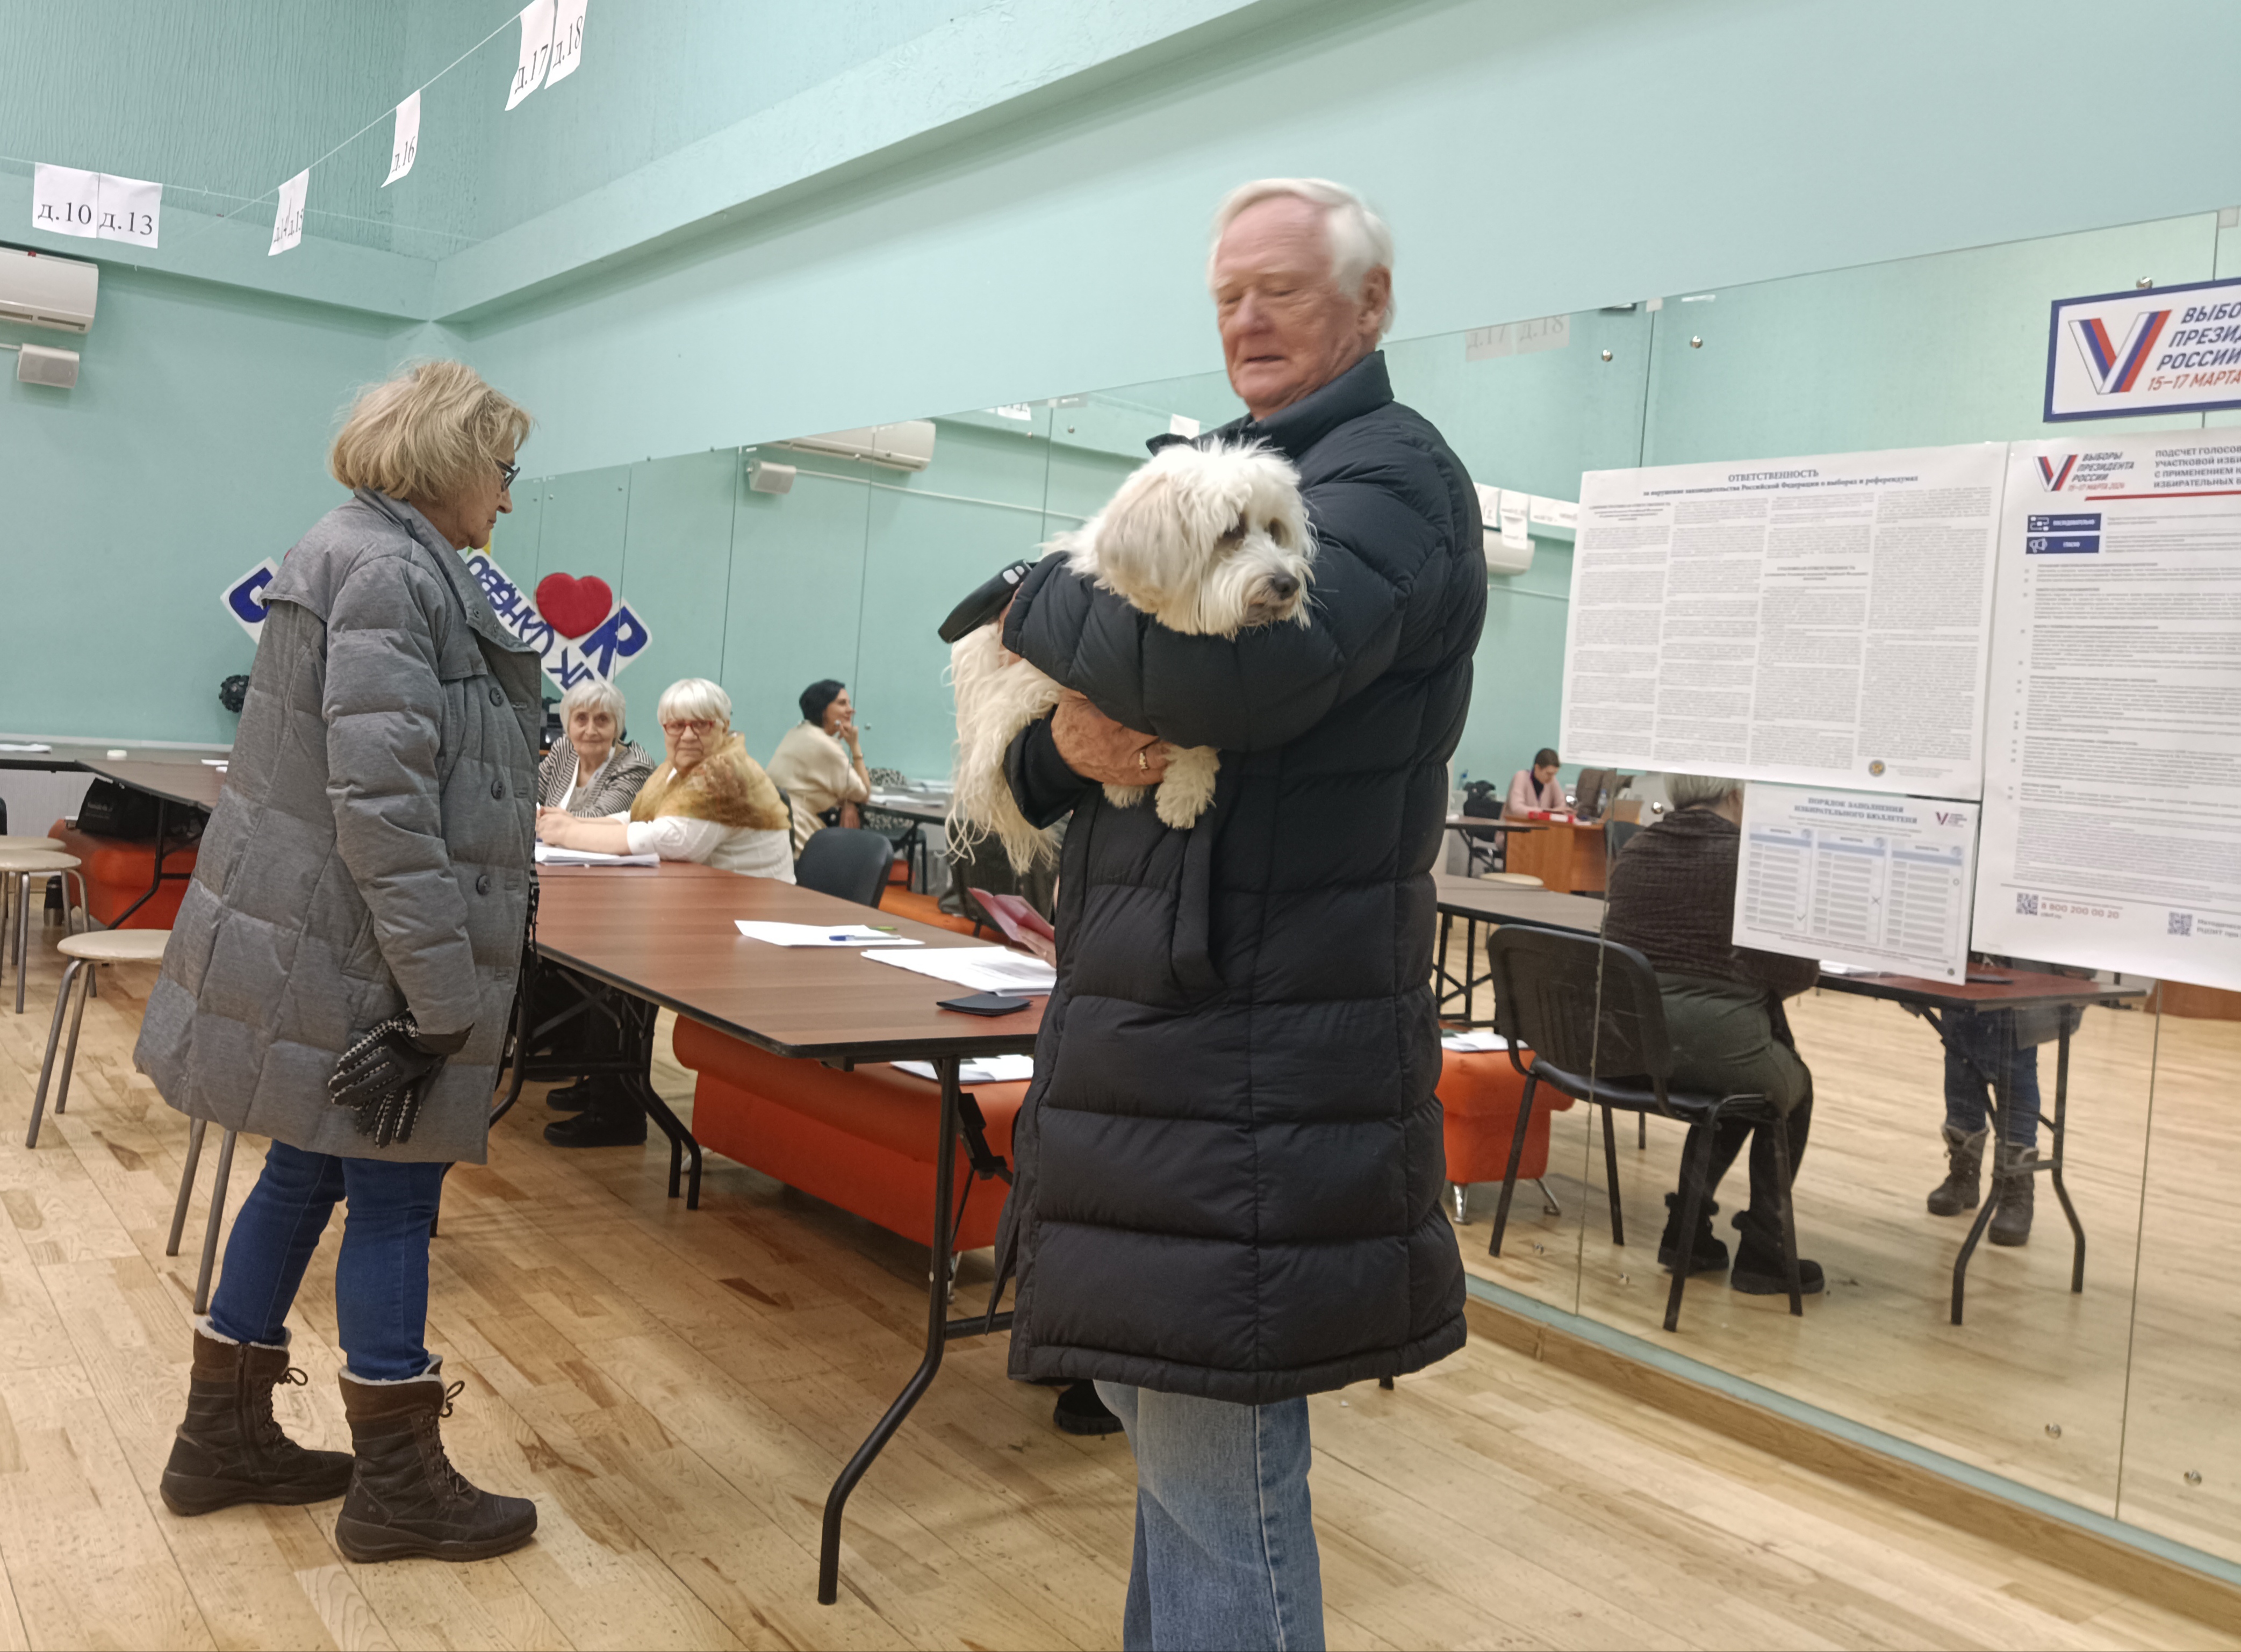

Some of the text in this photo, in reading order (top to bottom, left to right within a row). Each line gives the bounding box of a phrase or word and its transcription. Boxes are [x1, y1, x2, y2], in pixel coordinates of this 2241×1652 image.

[552, 16, 583, 69] д.18
[514, 44, 549, 95] д.17
[391, 135, 416, 173] д.16
[38, 202, 92, 225] д.10
[99, 212, 153, 235] д.13
[2156, 347, 2241, 371] РОССИИ
[2082, 451, 2123, 462] ВЫБОРЫ
[2199, 445, 2241, 455] ГОЛОСОВ
[2077, 461, 2135, 472] ПРЕЗИДЕНТА
[2154, 456, 2215, 468] УЧАСТКОВОЙ
[1728, 469, 1819, 483] ОТВЕТСТВЕННОСТЬ
[2072, 473, 2109, 483] РОССИИ
[2163, 468, 2233, 478] ПРИМЕНЕНИЕМ
[1741, 483, 1779, 492] Российской
[1782, 481, 1820, 490] Федерации
[1827, 478, 1857, 486] выборах
[1865, 476, 1918, 486] референдумах
[2153, 478, 2234, 489] ИЗБИРАТЕЛЬНЫХ
